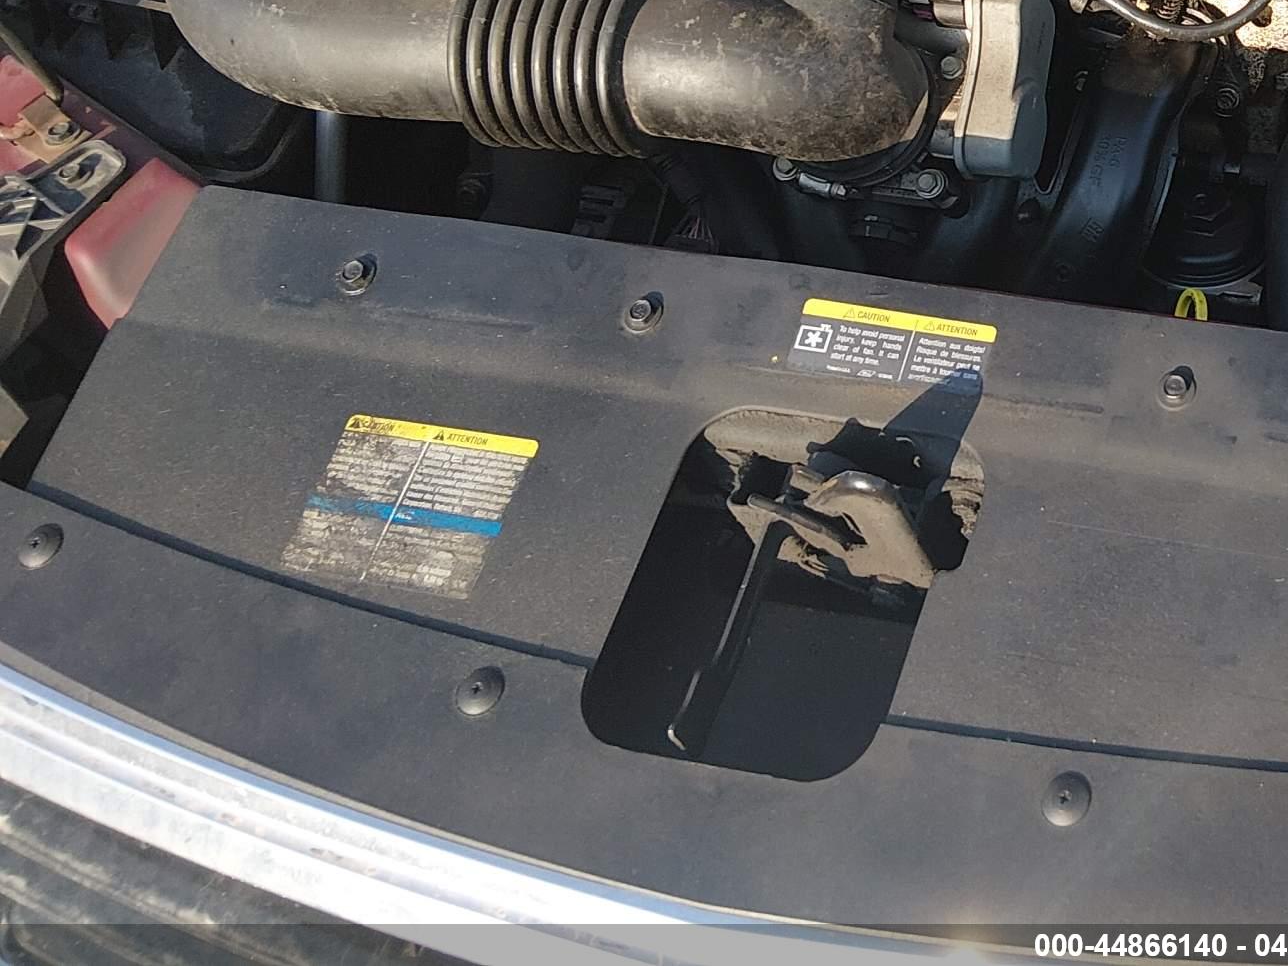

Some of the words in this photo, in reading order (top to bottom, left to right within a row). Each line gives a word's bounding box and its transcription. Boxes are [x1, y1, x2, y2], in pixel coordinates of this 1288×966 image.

[857, 310, 891, 323] CAUTION
[936, 323, 979, 336] ATTENTION
[446, 433, 489, 446] ATTENTION
